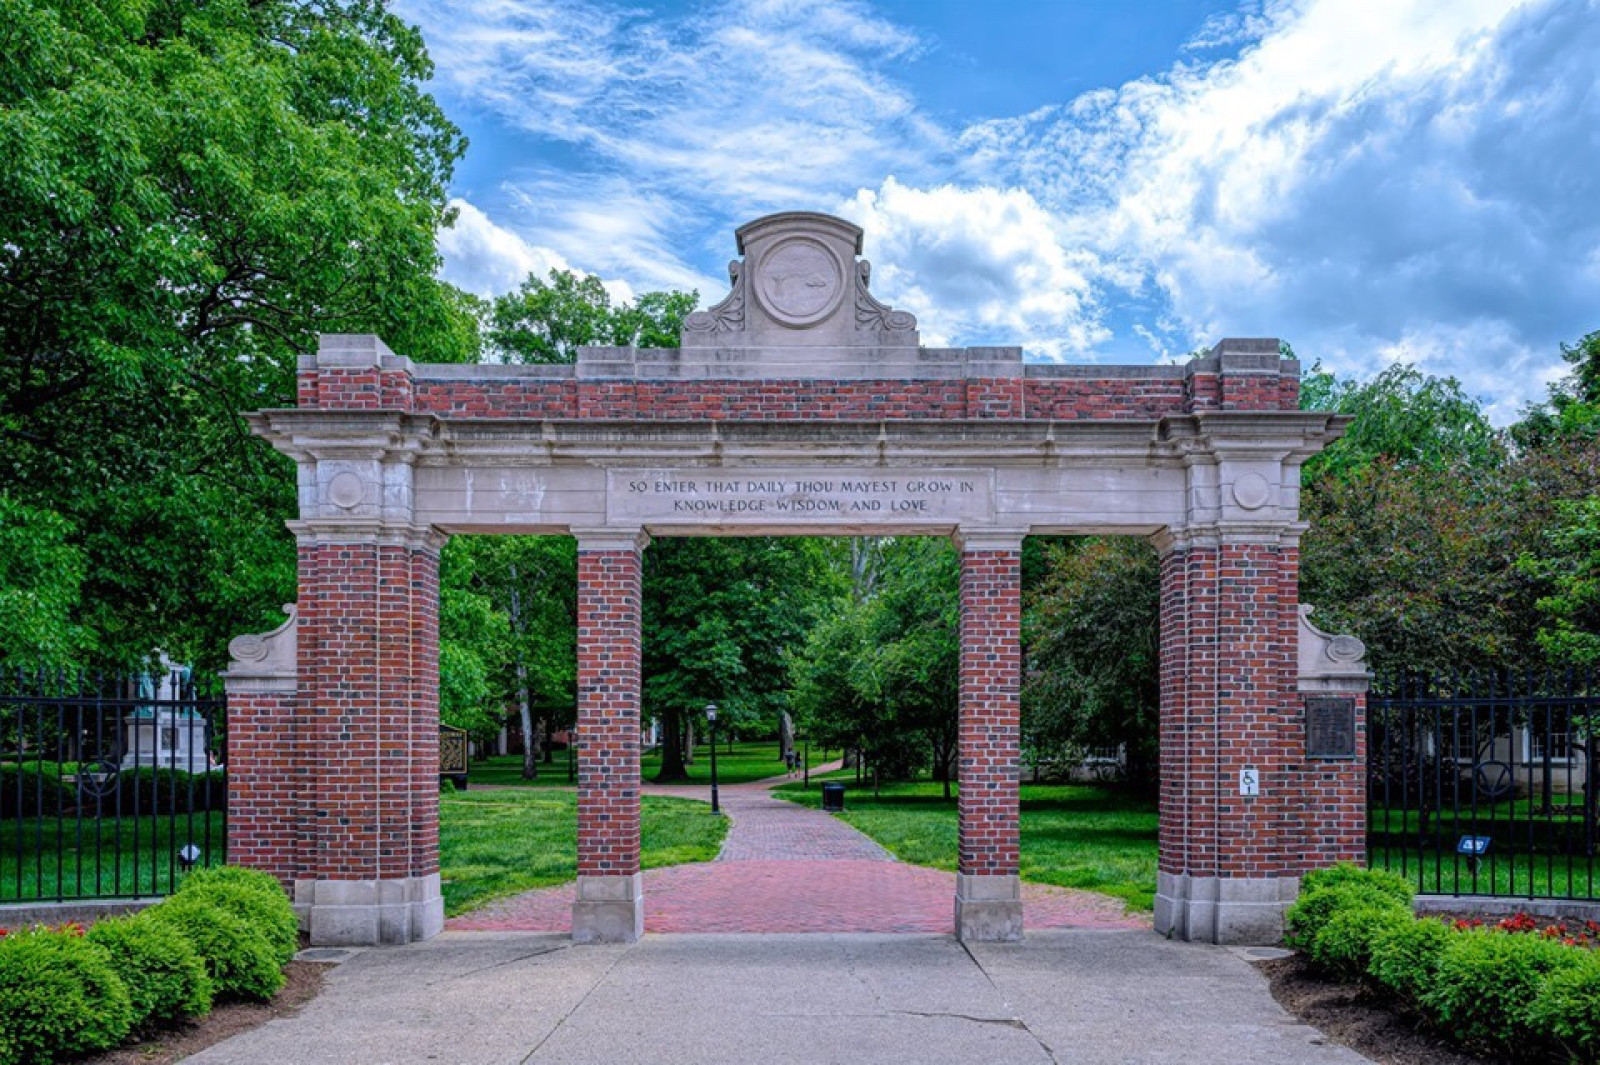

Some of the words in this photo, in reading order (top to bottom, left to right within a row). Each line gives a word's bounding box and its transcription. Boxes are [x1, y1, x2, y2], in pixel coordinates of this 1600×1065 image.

[628, 481, 648, 493] SO
[654, 481, 698, 493] ENTER
[705, 481, 740, 493] THAT
[747, 481, 786, 493] DAILY
[795, 481, 833, 493] THOU
[840, 481, 897, 493] MAYEST
[906, 481, 953, 493] GROW
[960, 481, 974, 493] IN
[674, 499, 766, 511] KNOWLEDGE
[776, 499, 840, 511] WISDOM
[850, 499, 881, 511] AND
[891, 499, 928, 511] LOVE
